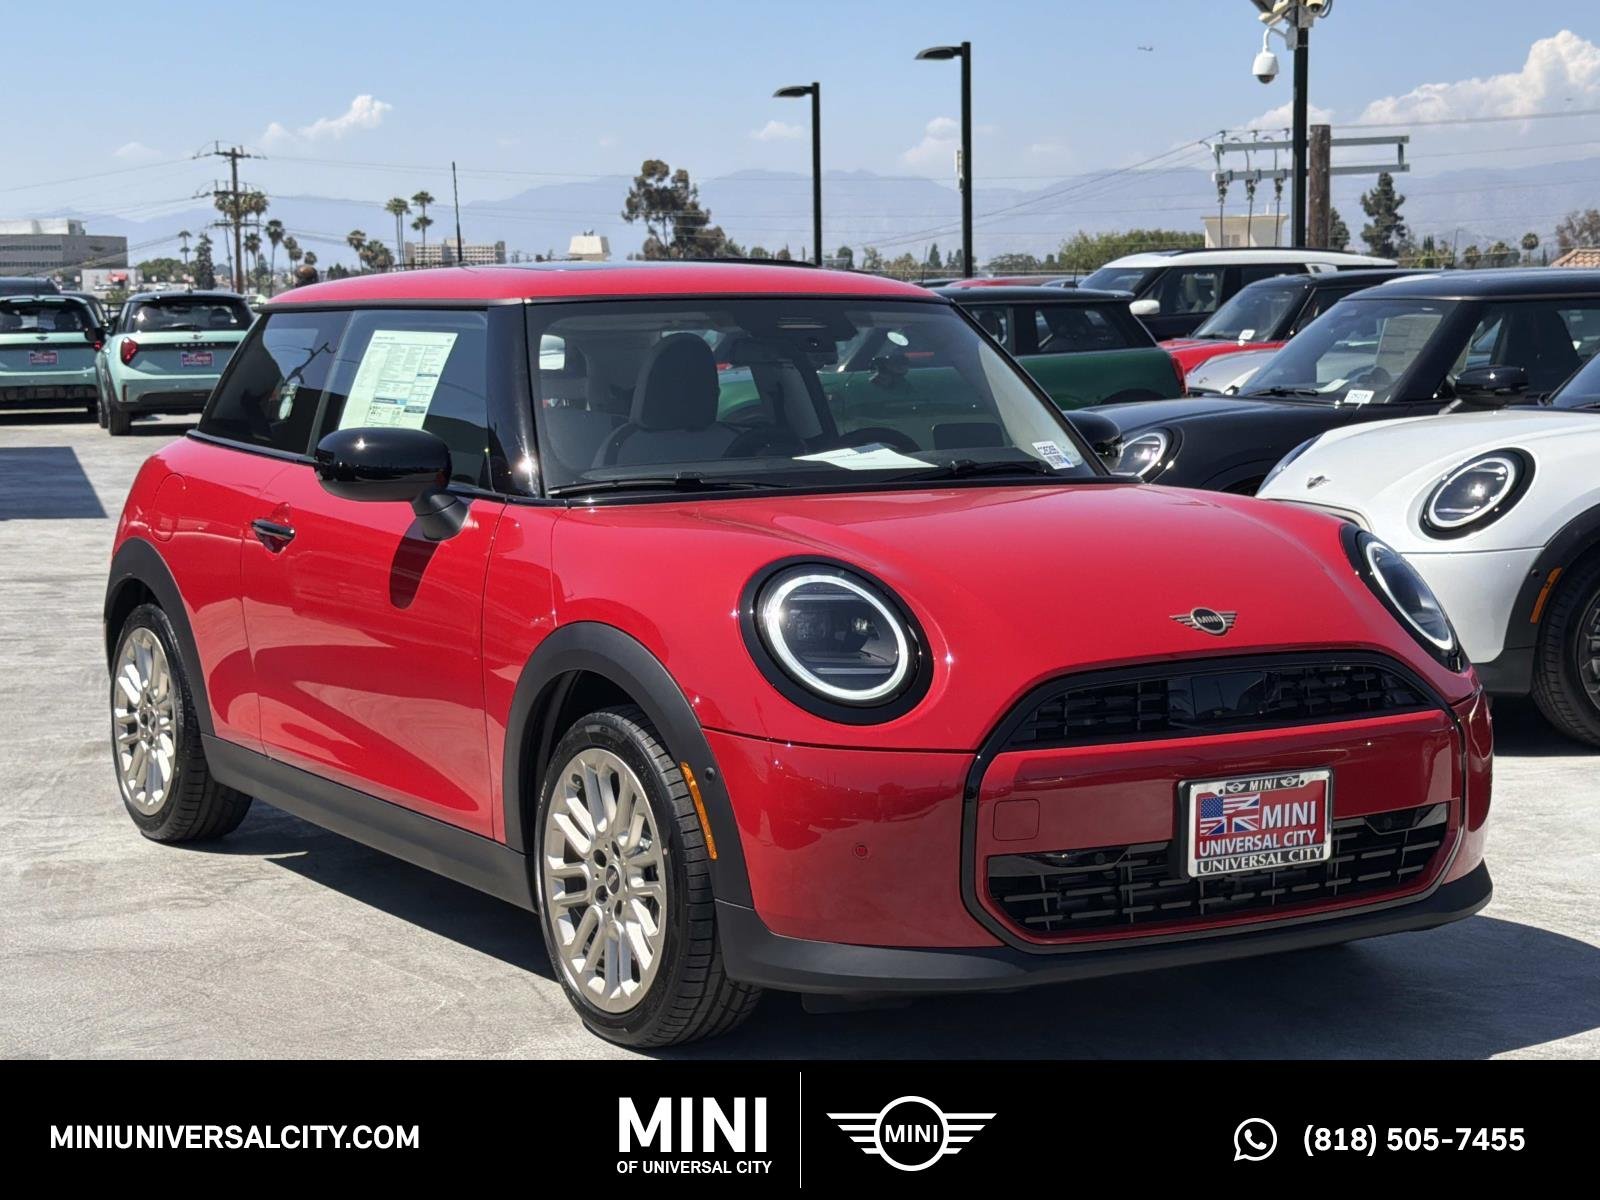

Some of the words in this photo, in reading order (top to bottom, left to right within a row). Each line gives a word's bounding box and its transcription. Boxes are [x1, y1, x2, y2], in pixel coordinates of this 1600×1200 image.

[1249, 778, 1277, 791] MINI
[1261, 800, 1316, 830] MINI
[1200, 834, 1280, 857] UNIVERSAL
[1283, 829, 1317, 847] CITY
[1200, 852, 1285, 873] UNIVERSAL
[1288, 846, 1323, 861] CITY
